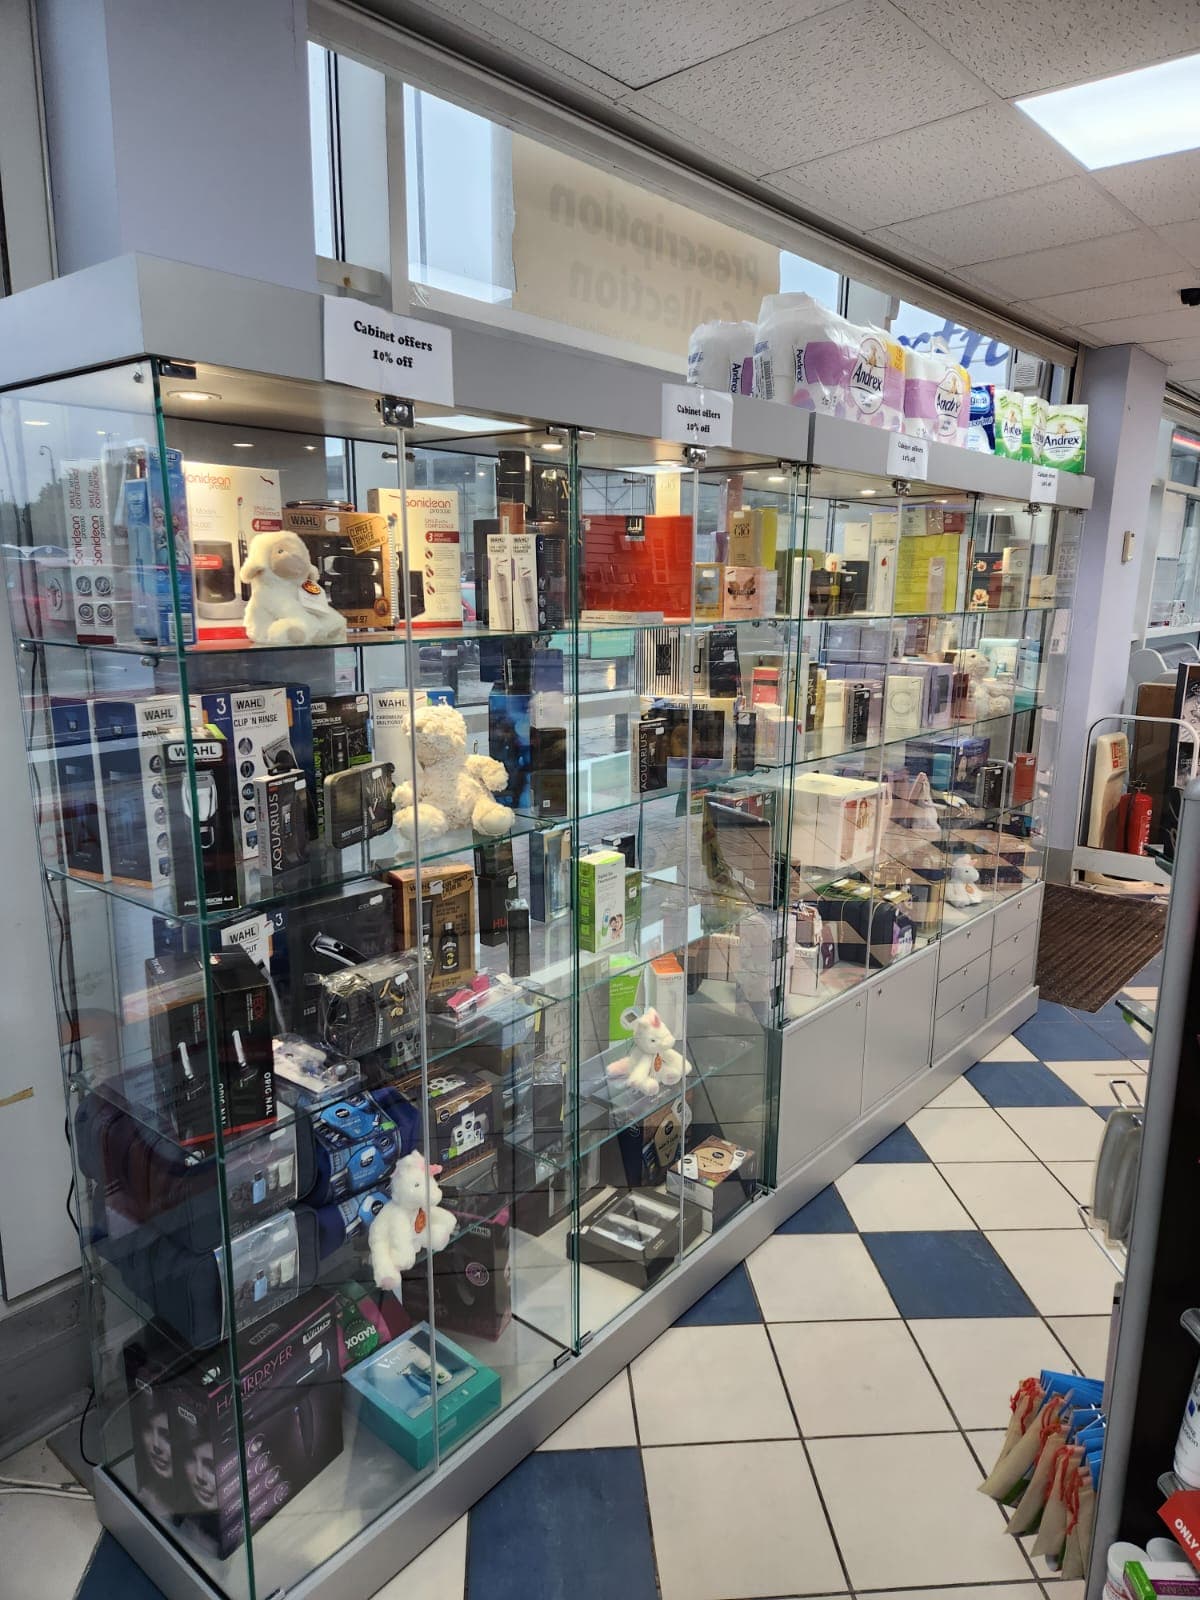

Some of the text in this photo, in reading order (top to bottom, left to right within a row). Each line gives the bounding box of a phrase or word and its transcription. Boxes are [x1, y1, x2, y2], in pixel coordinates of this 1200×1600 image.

[353, 320, 433, 352] Cabinet offers
[373, 350, 413, 368] 10% off
[852, 362, 882, 391] Andrex
[677, 404, 720, 419] Cabinet offers
[687, 423, 710, 433] 10% off
[1043, 433, 1080, 448] Andrex
[186, 472, 231, 488] oniclean
[291, 515, 318, 526] WAHL
[236, 698, 263, 710] WAHL
[296, 691, 304, 705] 3
[379, 699, 407, 707] WAHL
[216, 698, 226, 715] 3
[144, 709, 173, 720] WAHL
[233, 718, 248, 728] CLIP
[258, 714, 278, 724] RINSE
[174, 745, 217, 757] WAHL
[640, 732, 648, 790] AQUARIUS
[269, 794, 283, 870] AQUARIUS
[275, 913, 283, 926] 3
[230, 927, 256, 943] WAHL
[345, 1325, 376, 1349] RADOX
[1174, 1518, 1199, 1549] ONLY
